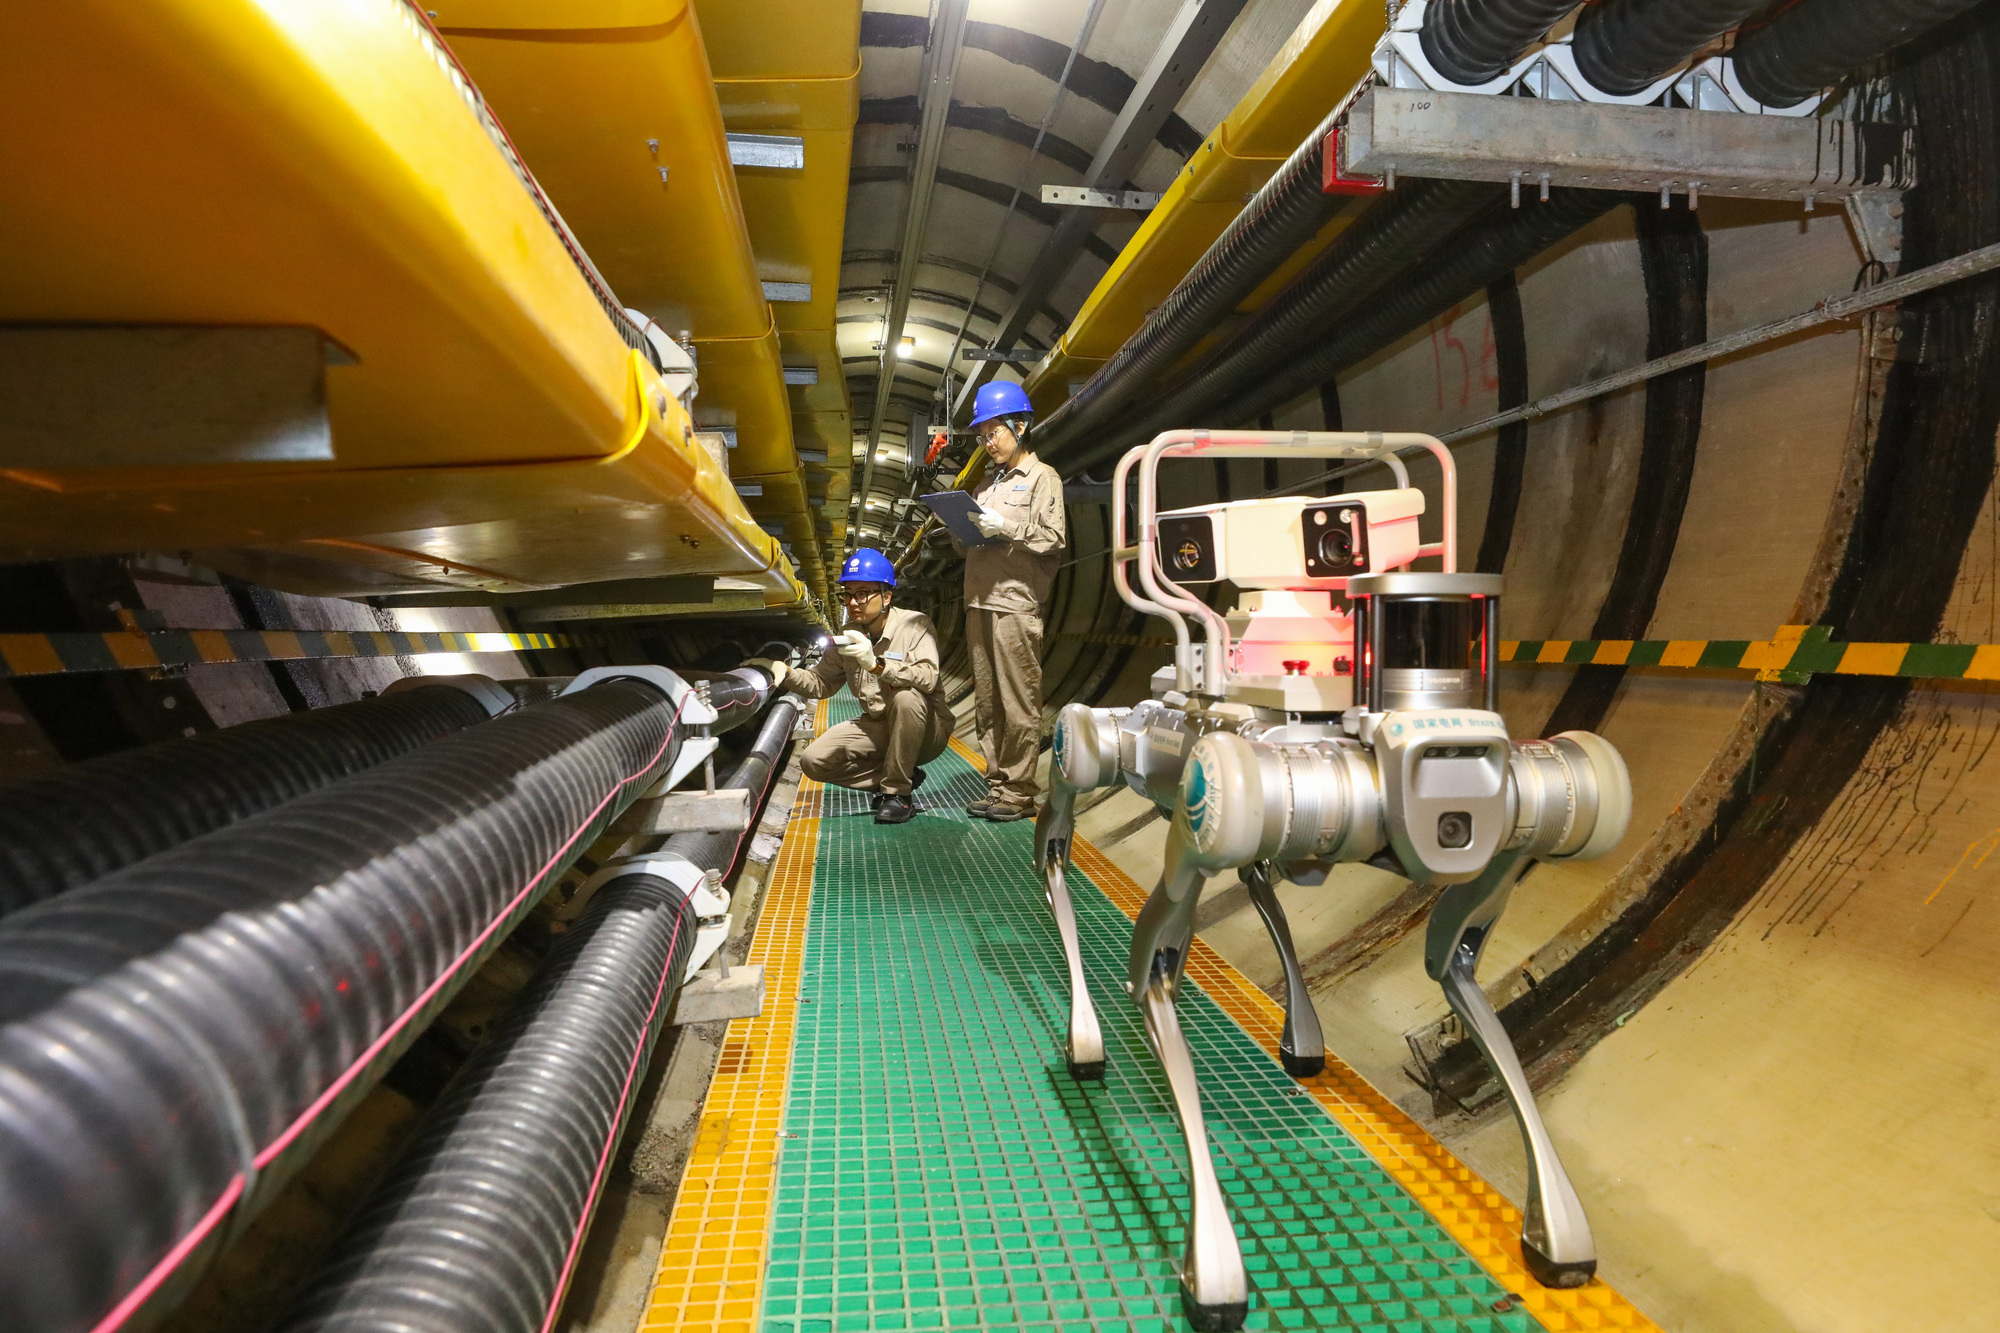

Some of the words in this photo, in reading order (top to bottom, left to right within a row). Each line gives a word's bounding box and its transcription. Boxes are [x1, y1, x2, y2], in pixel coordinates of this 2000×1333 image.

[1410, 102, 1431, 112] 100
[1414, 717, 1462, 729] 国家电网
